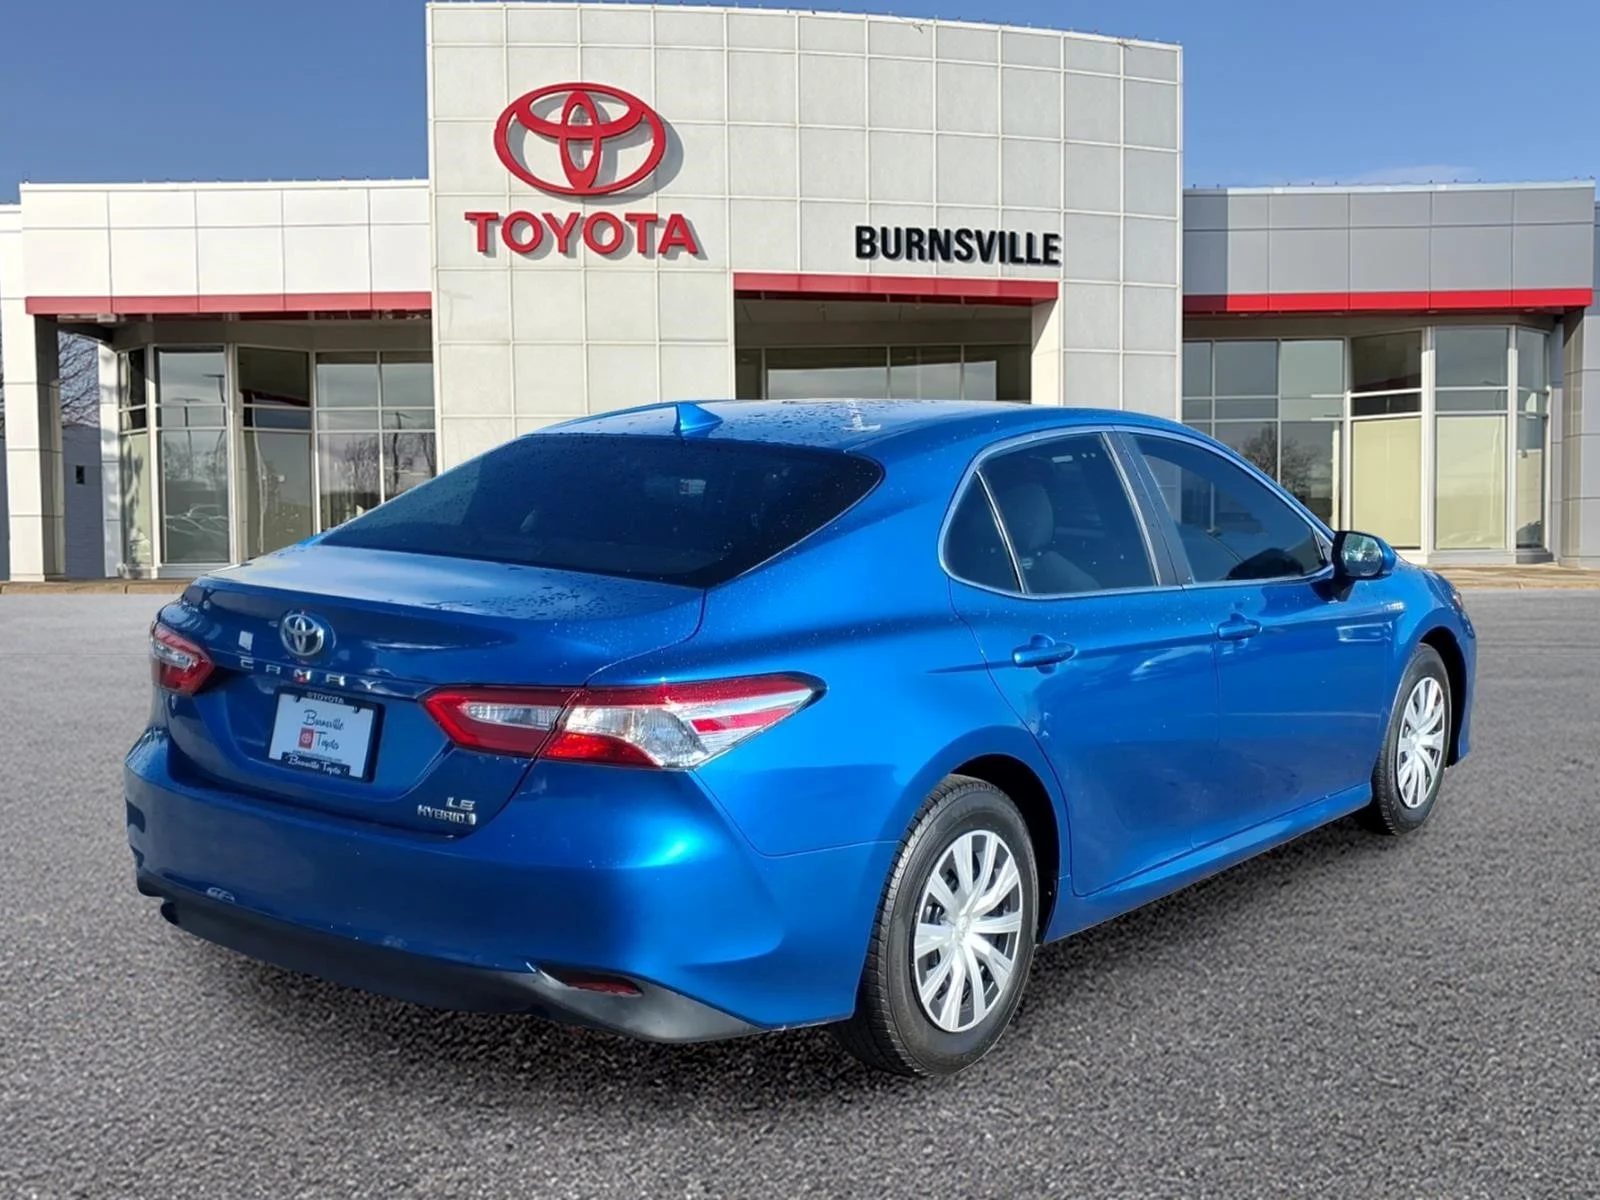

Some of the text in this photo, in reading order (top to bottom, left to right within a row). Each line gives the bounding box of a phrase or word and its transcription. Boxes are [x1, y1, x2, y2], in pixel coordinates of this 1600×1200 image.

[464, 211, 699, 254] TOYOTA
[855, 225, 1062, 266] BURNSVILLE
[239, 655, 382, 690] CAMRY
[312, 691, 345, 704] TOYOTA
[303, 709, 345, 731] Burnsville
[315, 730, 340, 751] Toyota
[417, 804, 465, 824] HYBRID
[446, 796, 476, 811] LE
